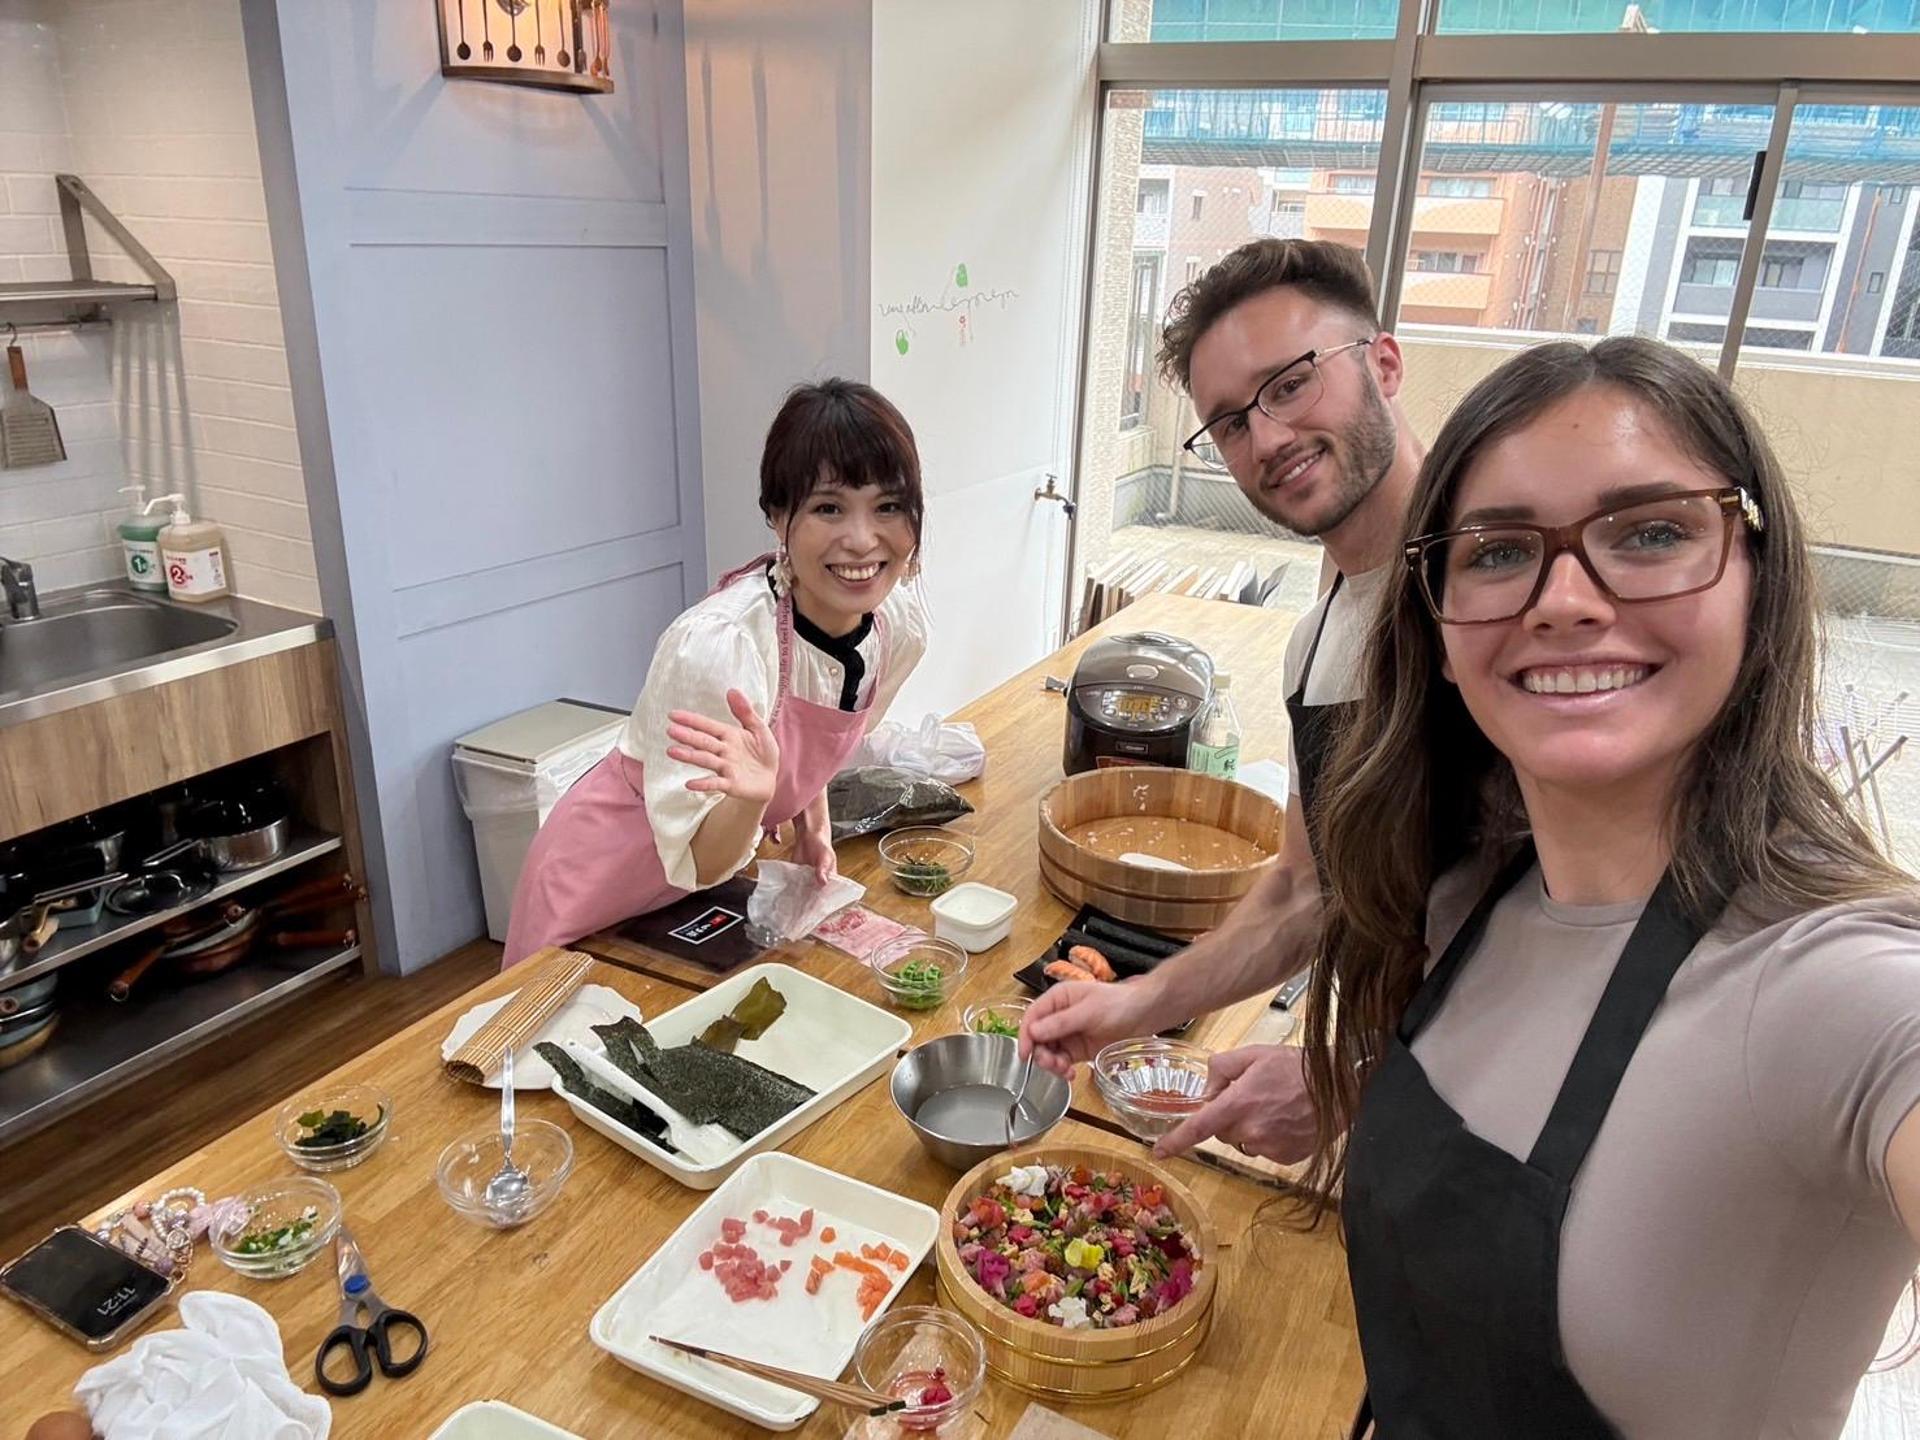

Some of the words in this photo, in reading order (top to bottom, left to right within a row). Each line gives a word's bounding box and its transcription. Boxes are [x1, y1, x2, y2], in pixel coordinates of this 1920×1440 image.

[172, 567, 183, 583] 2
[780, 627, 789, 645] feel
[781, 647, 789, 656] to
[97, 1287, 136, 1315] 11:21
